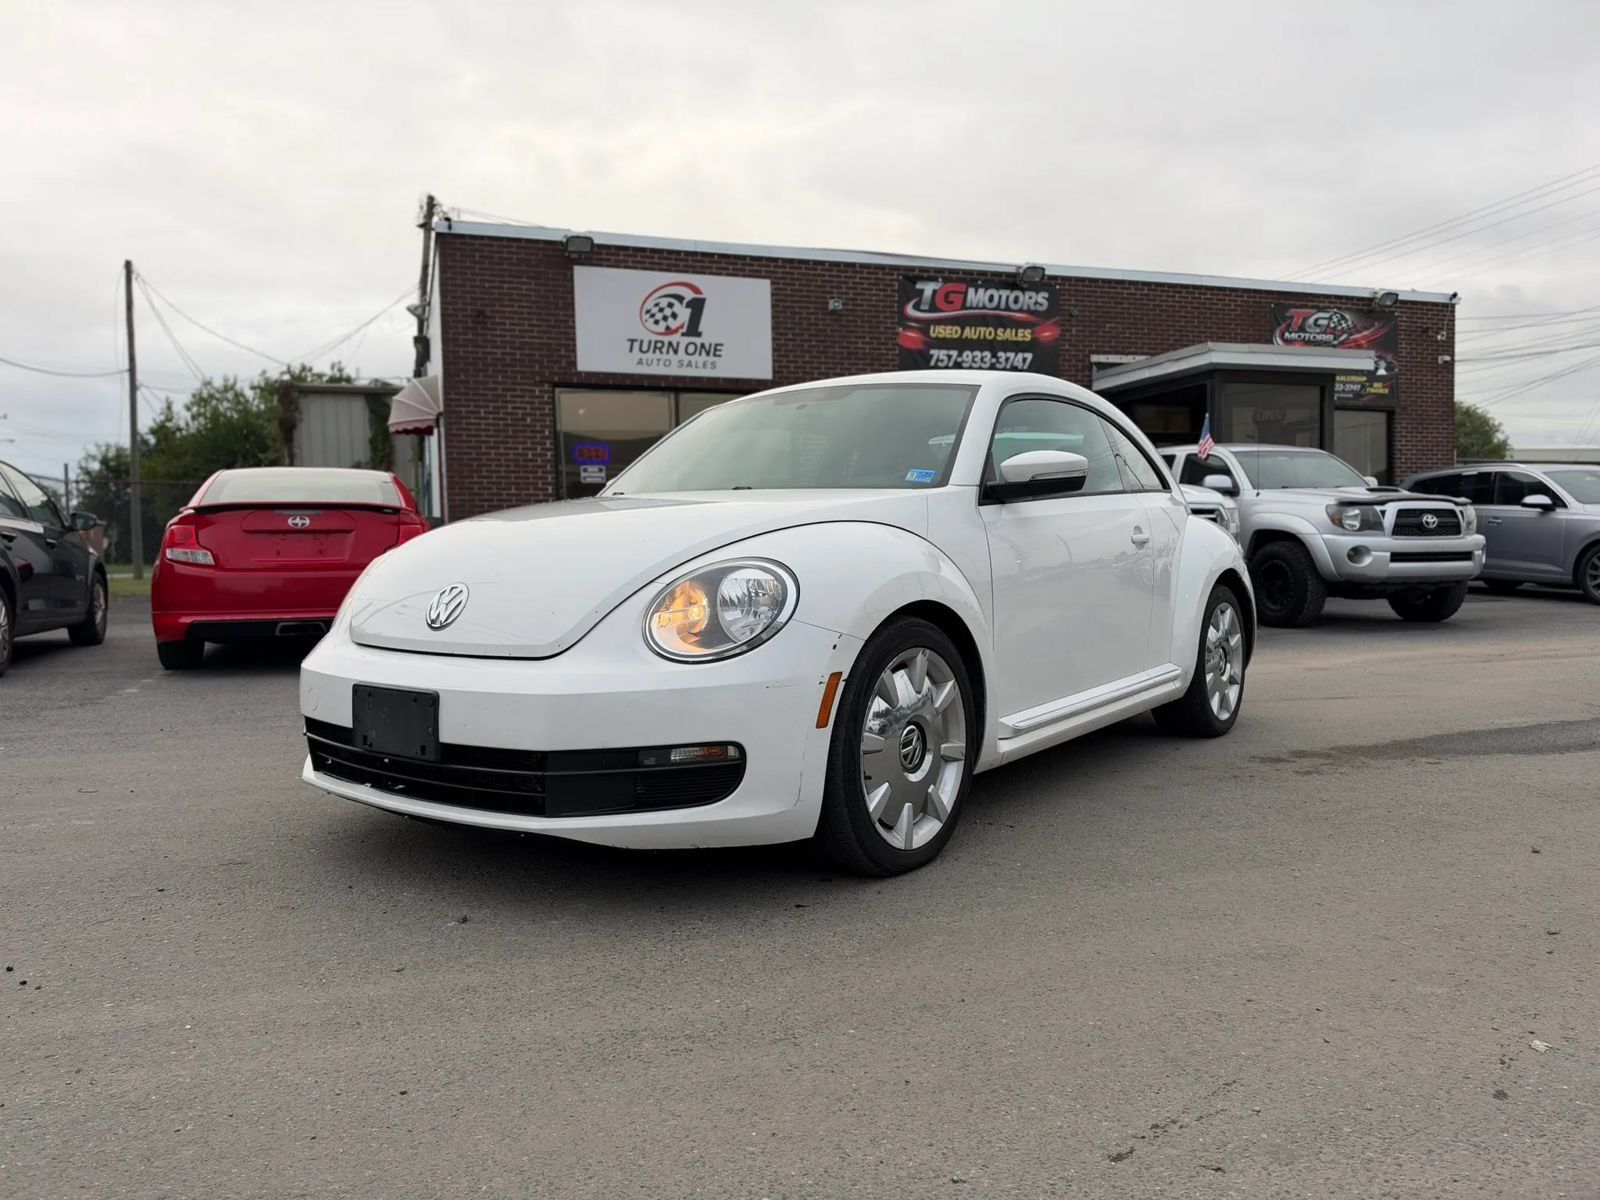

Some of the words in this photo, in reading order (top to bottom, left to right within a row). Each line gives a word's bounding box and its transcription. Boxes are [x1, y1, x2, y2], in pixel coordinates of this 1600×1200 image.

[915, 281, 967, 312] TG
[966, 287, 1049, 312] MOTORS
[929, 325, 961, 339] USED
[962, 326, 995, 340] AUTO
[997, 328, 1032, 342] SALES
[1283, 332, 1334, 342] MOTORS
[627, 338, 680, 356] TURN
[684, 341, 724, 358] ONE
[636, 358, 672, 368] AUTO
[677, 359, 717, 370] SALES
[929, 350, 1033, 370] 757-933-3747
